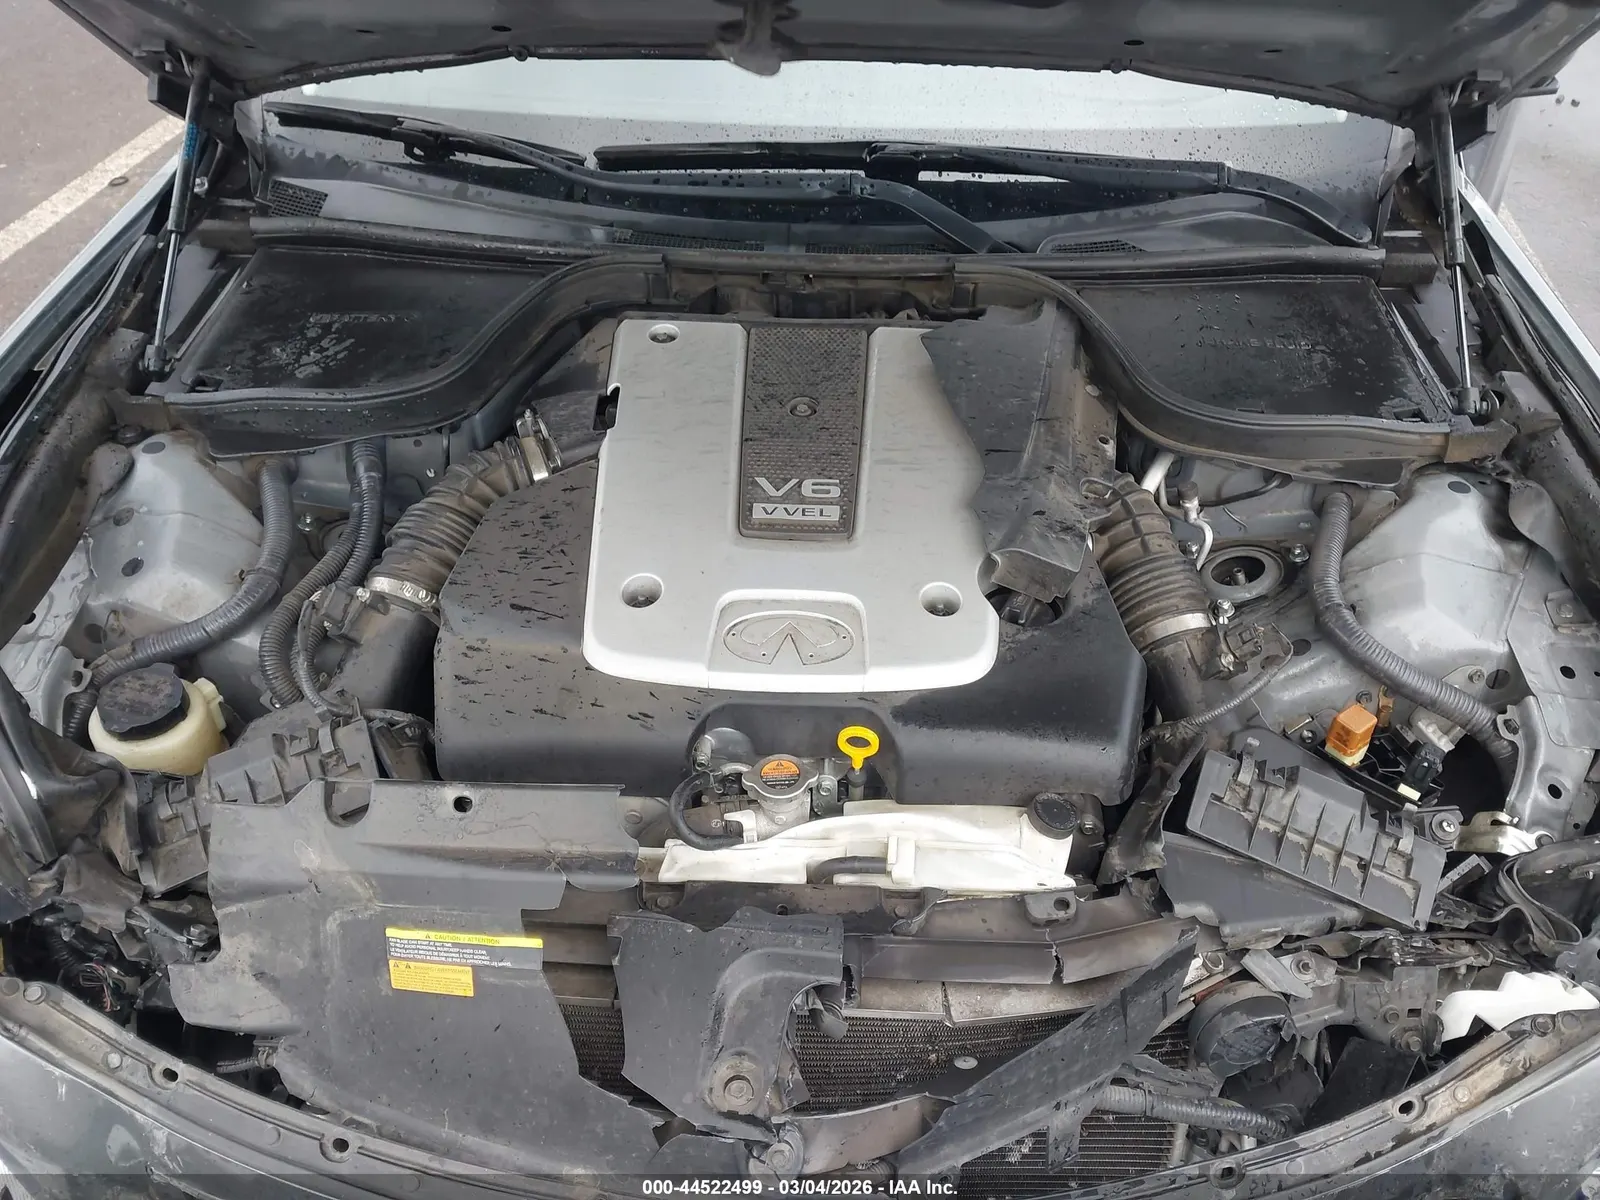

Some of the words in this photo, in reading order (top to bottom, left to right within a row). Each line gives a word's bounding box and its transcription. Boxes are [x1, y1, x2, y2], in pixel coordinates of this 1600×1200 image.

[754, 477, 841, 498] V6
[761, 506, 832, 518] VVEL
[467, 936, 500, 944] ATTENTION
